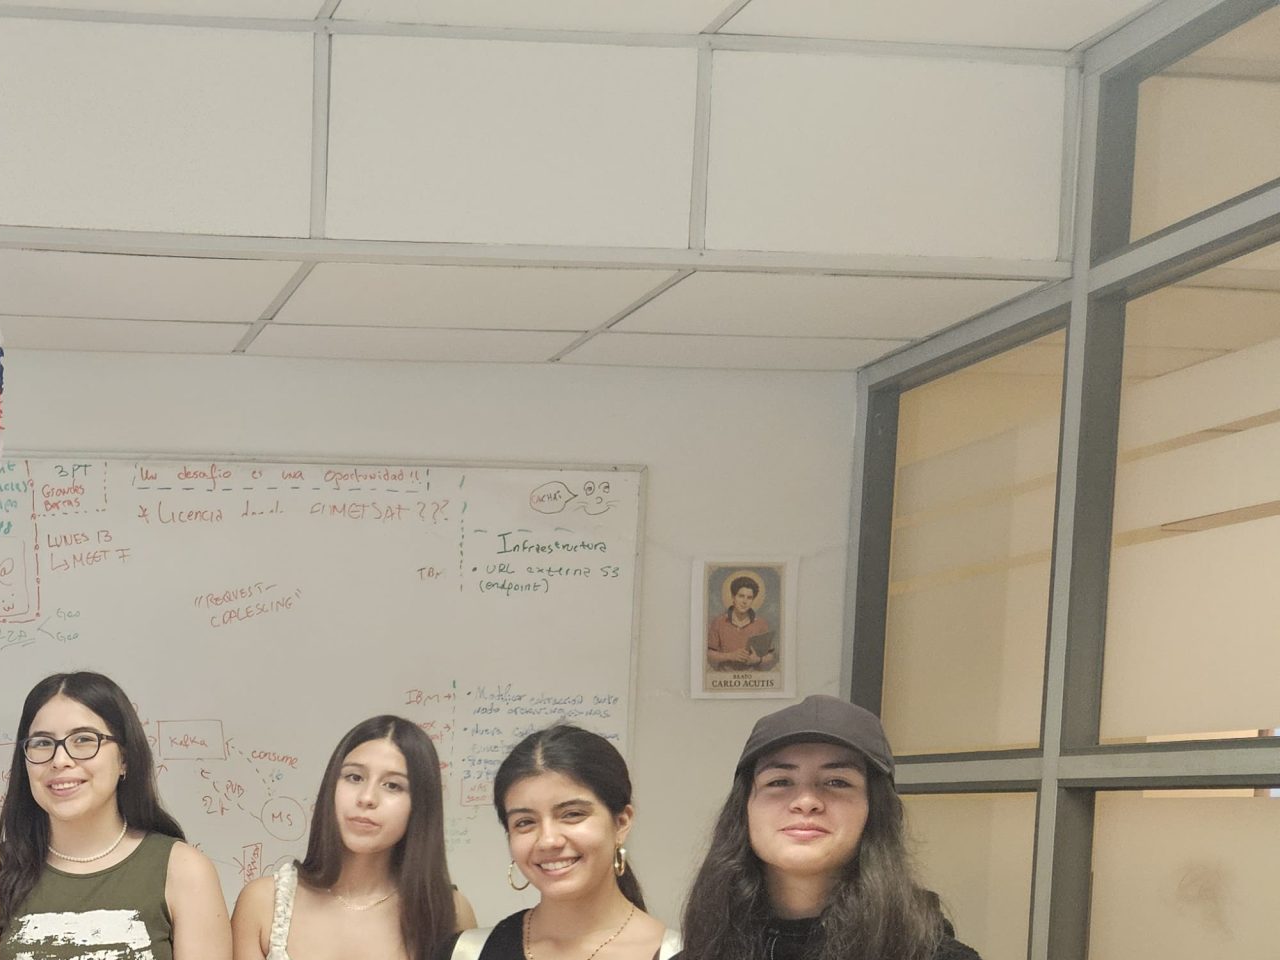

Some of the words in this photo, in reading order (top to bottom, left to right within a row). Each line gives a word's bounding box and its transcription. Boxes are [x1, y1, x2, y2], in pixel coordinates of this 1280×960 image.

[158, 500, 223, 524] Licencia
[47, 533, 90, 548] LUNES
[97, 529, 112, 544] 13
[73, 549, 111, 568] MEET
[486, 563, 515, 575] URL
[479, 578, 549, 597] (endpoint)
[711, 680, 741, 688] CARLO
[742, 680, 775, 688] ACUTIS
[251, 750, 299, 770] consume
